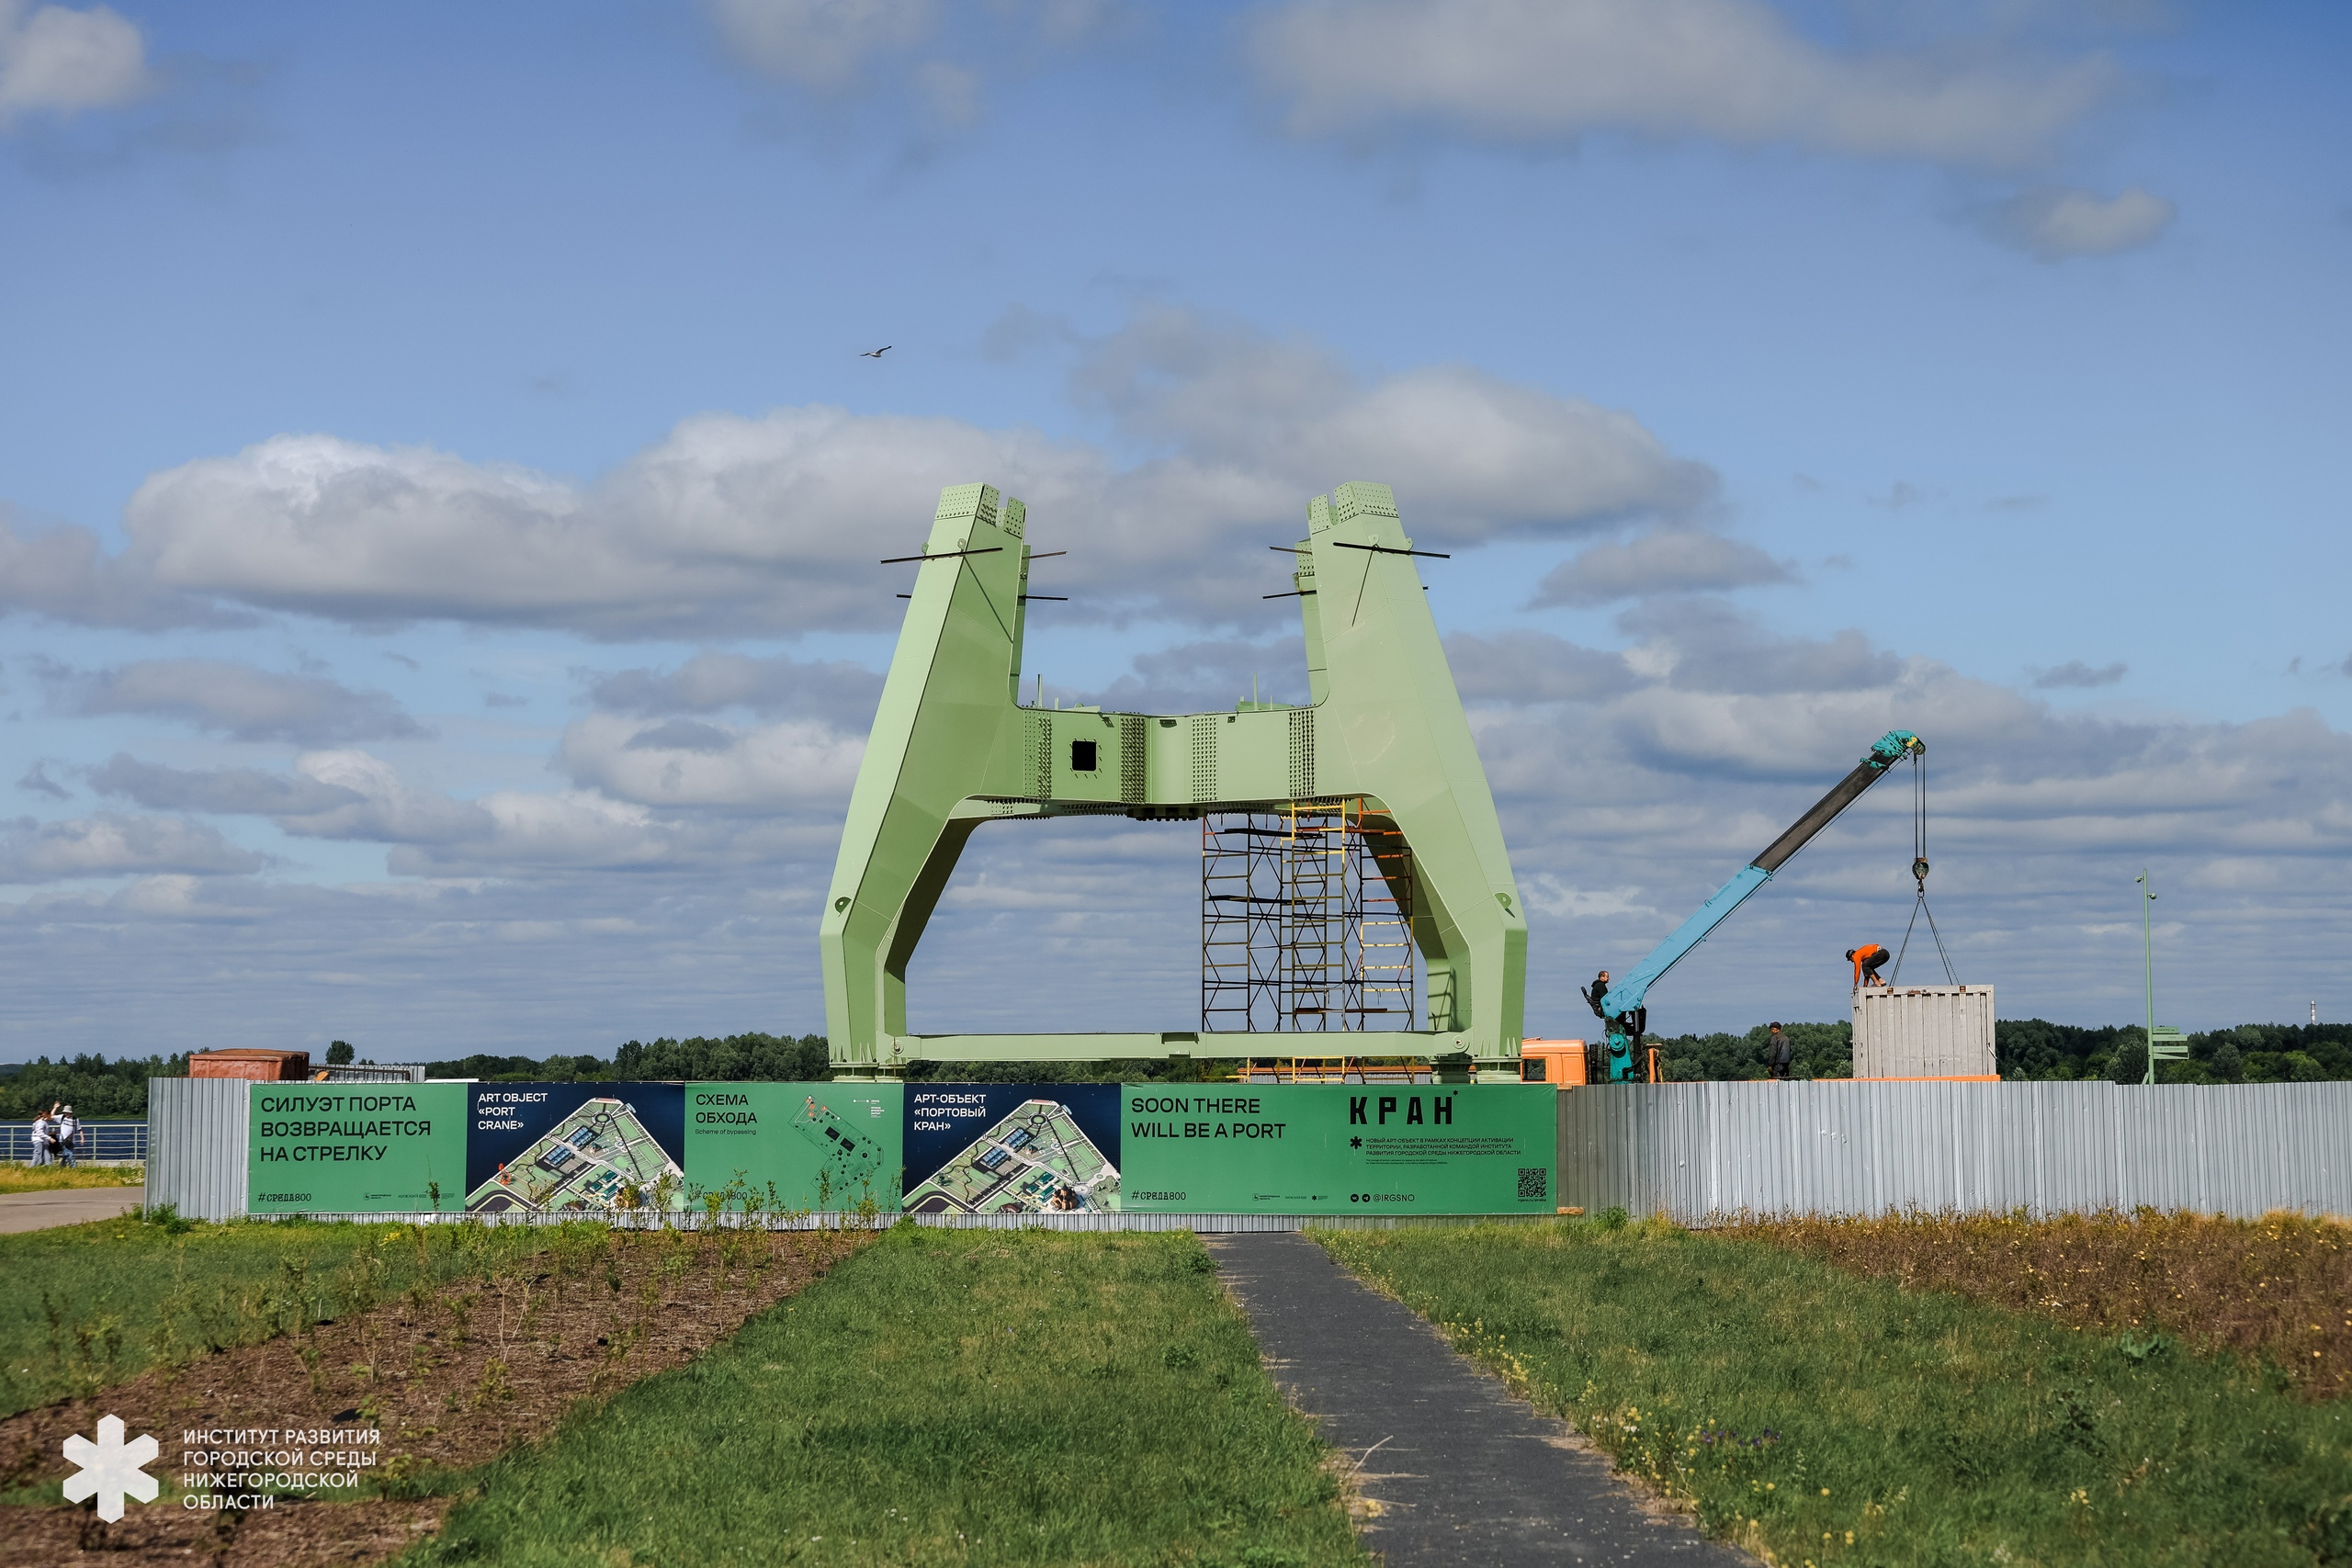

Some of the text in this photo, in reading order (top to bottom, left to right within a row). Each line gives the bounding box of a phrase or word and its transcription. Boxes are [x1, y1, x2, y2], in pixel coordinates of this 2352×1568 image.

[478, 1093, 548, 1102] ART OBJECT
[695, 1094, 749, 1106] СХЕМА
[914, 1094, 986, 1104] АРТ-ОБЪЕКТ
[261, 1096, 417, 1112] СИЛУЭТ ПОРТА
[1131, 1098, 1261, 1113] SOON THERE
[478, 1107, 515, 1116] «PORT
[914, 1106, 986, 1117] «ПОРТОВЫЙ
[1350, 1097, 1453, 1125] КРАН
[695, 1112, 757, 1125] ОБХОДА
[261, 1121, 431, 1139] ВОЗВРАЩАЕТСЯ
[478, 1121, 524, 1130] CRANE»
[914, 1122, 951, 1131] КРАН»
[1131, 1122, 1286, 1139] WILL BE A PORT
[261, 1145, 388, 1162] НА СТРЕЛКУ
[258, 1192, 311, 1202] #СРЕДА800
[1131, 1190, 1186, 1201] #СРЕДА800
[1373, 1194, 1415, 1202] @IRGSNO
